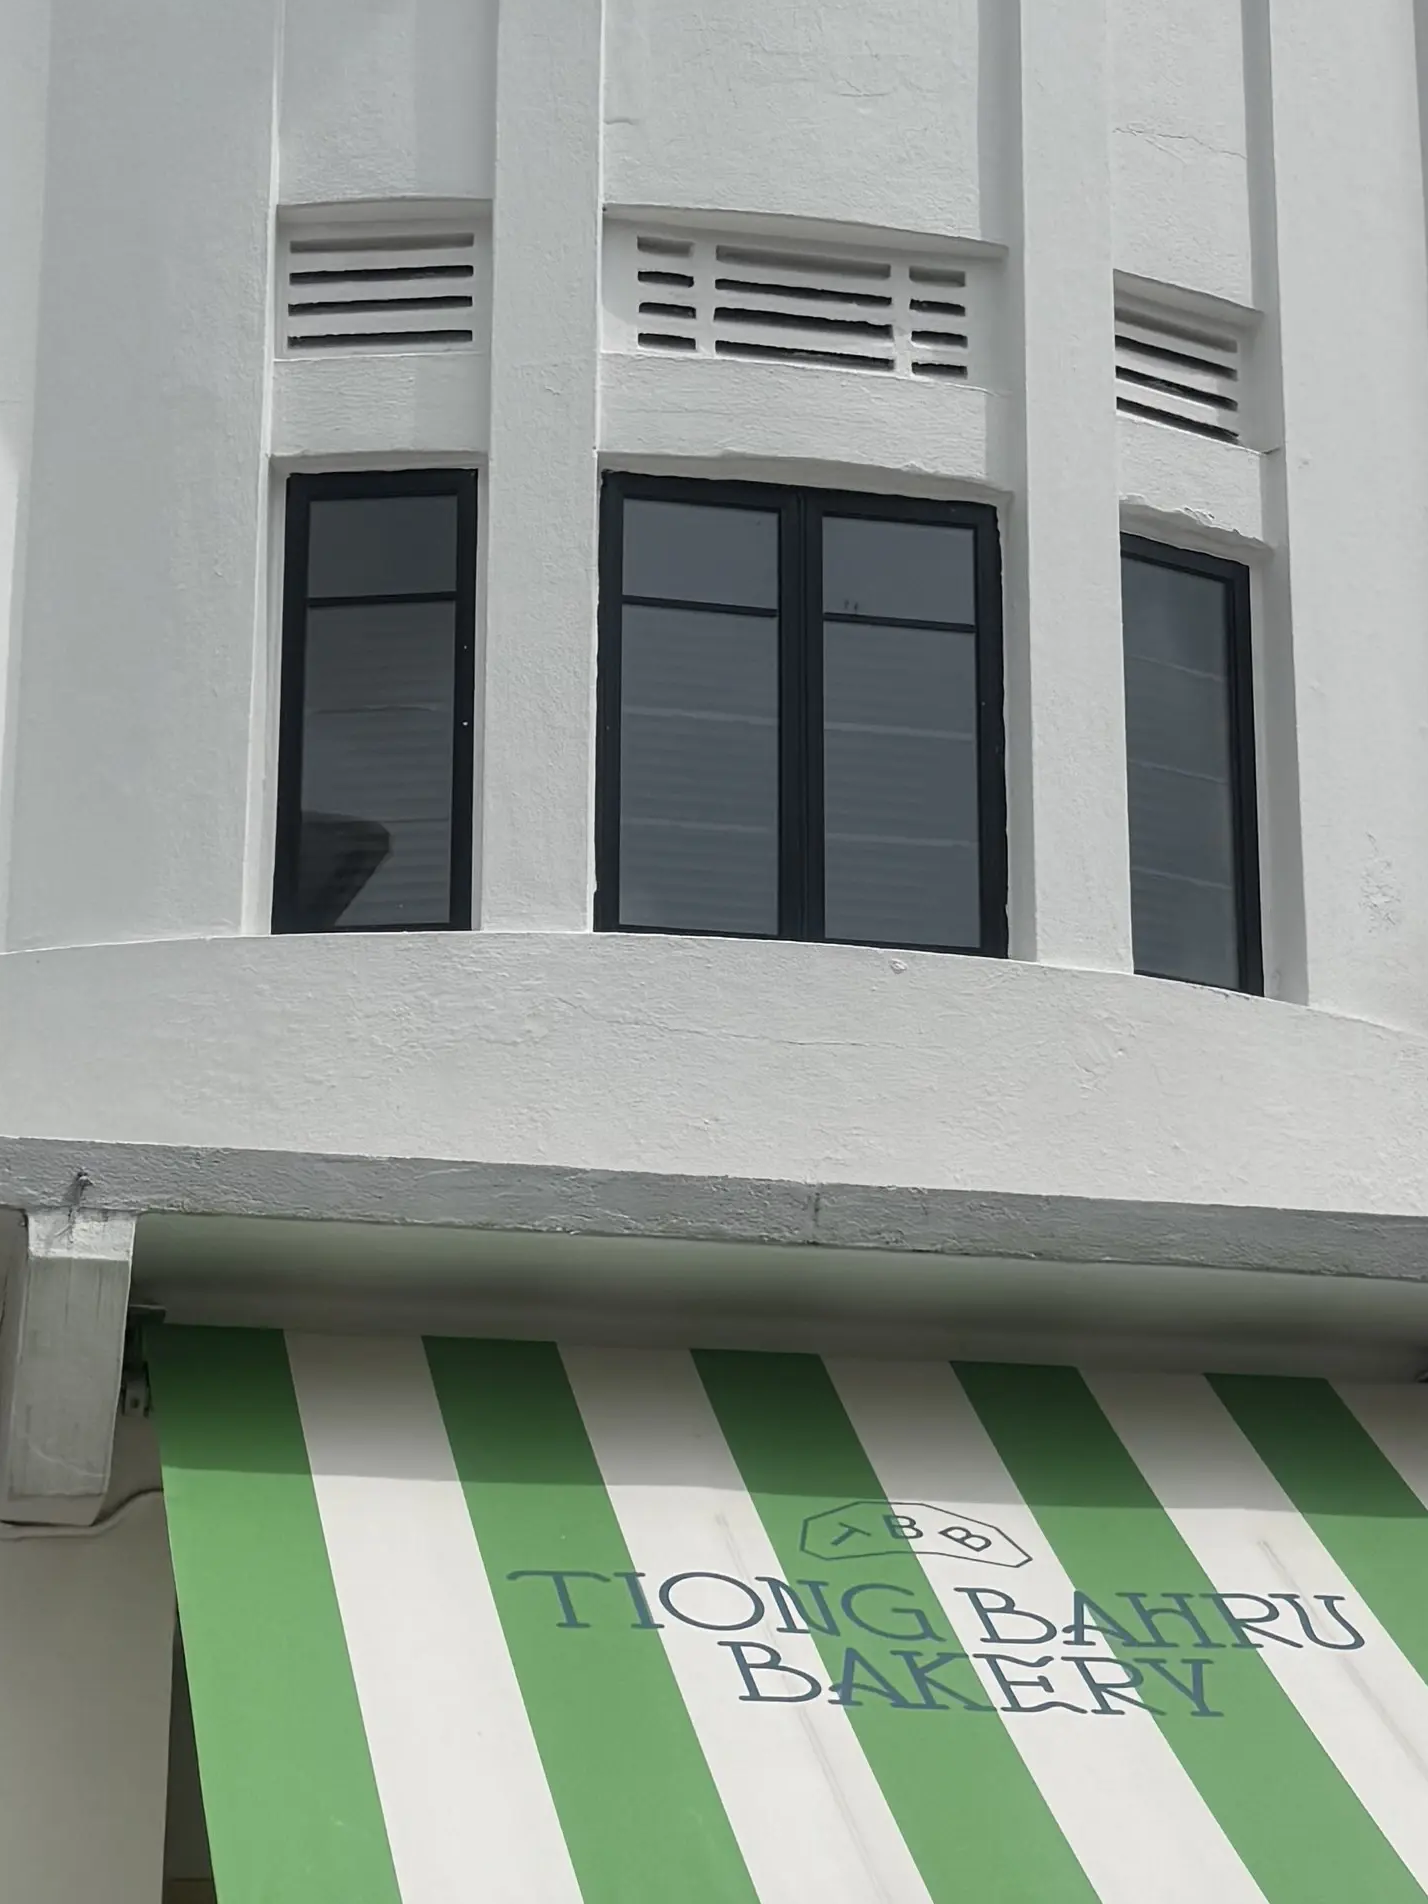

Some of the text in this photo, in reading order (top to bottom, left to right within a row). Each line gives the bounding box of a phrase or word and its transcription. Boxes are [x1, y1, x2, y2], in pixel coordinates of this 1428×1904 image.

[829, 1514, 993, 1553] TBB
[505, 1569, 1367, 1651] TIONG BAHRU
[716, 1639, 1225, 1718] BAKERY
